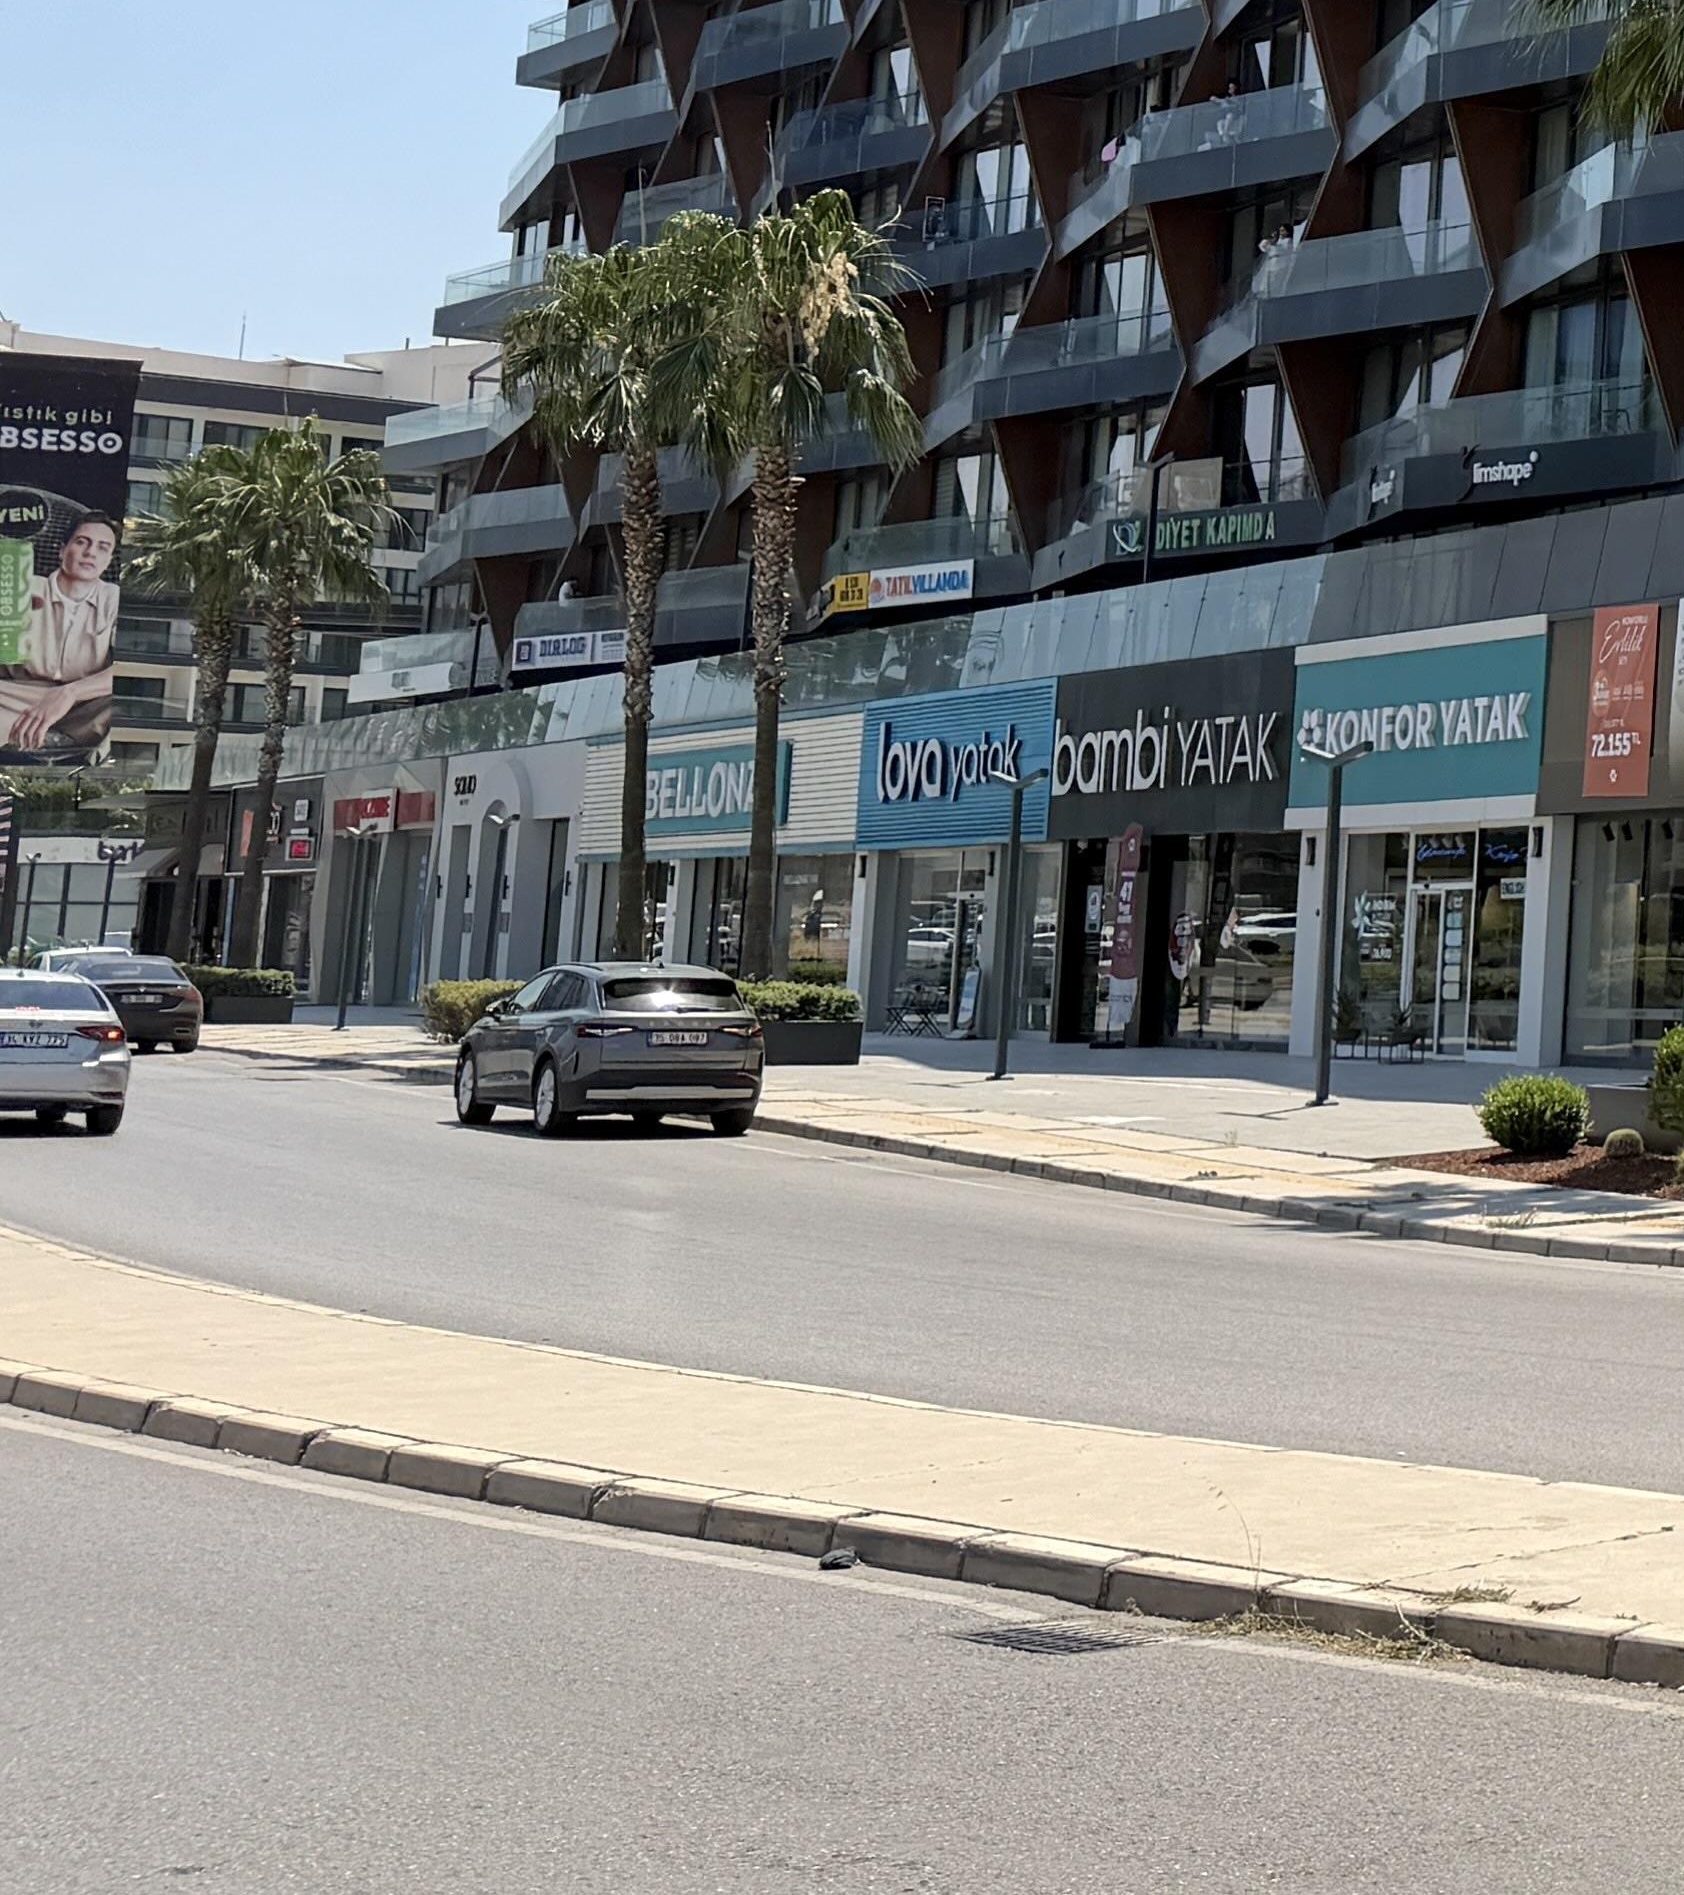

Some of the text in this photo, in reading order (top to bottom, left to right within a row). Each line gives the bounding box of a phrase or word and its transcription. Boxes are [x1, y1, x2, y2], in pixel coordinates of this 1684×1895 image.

[0, 404, 57, 422] ıstık
[0, 426, 123, 454] BSESSO
[1155, 517, 1200, 550] DİYET
[1326, 692, 1530, 752] KONFOR YATAK
[1052, 706, 1278, 796] bambi YATAK
[1591, 732, 1632, 757] 72.155
[877, 721, 1020, 803] lova yatak
